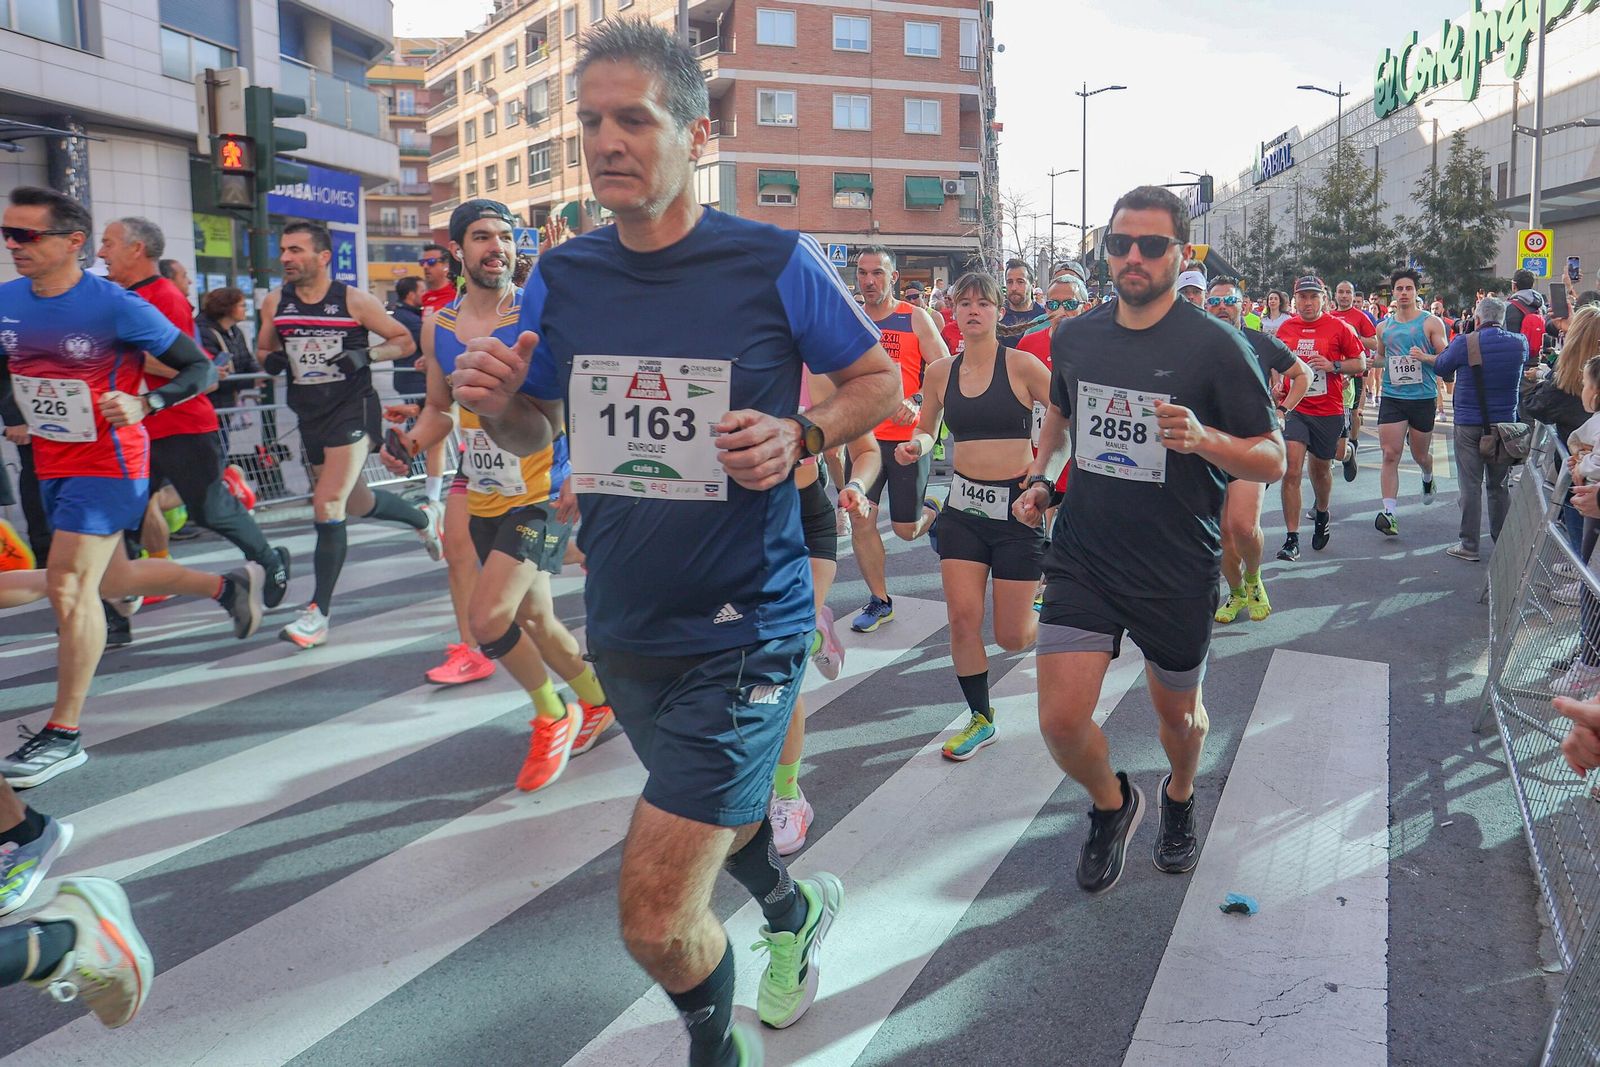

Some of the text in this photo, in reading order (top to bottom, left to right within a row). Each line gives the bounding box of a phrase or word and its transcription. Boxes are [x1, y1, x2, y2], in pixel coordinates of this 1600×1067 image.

[1529, 238, 1542, 246] 30
[299, 352, 326, 365] 435
[1395, 364, 1416, 373] 1186
[32, 399, 67, 416] 226
[600, 403, 696, 442] 1163
[1089, 414, 1147, 444] 2858
[627, 441, 667, 454] ENRIQUE
[1105, 440, 1129, 451] MANUEL
[653, 466, 660, 474] 3
[961, 482, 996, 504] 1446
[713, 613, 744, 625] adidas
[749, 684, 785, 705] NIKE
